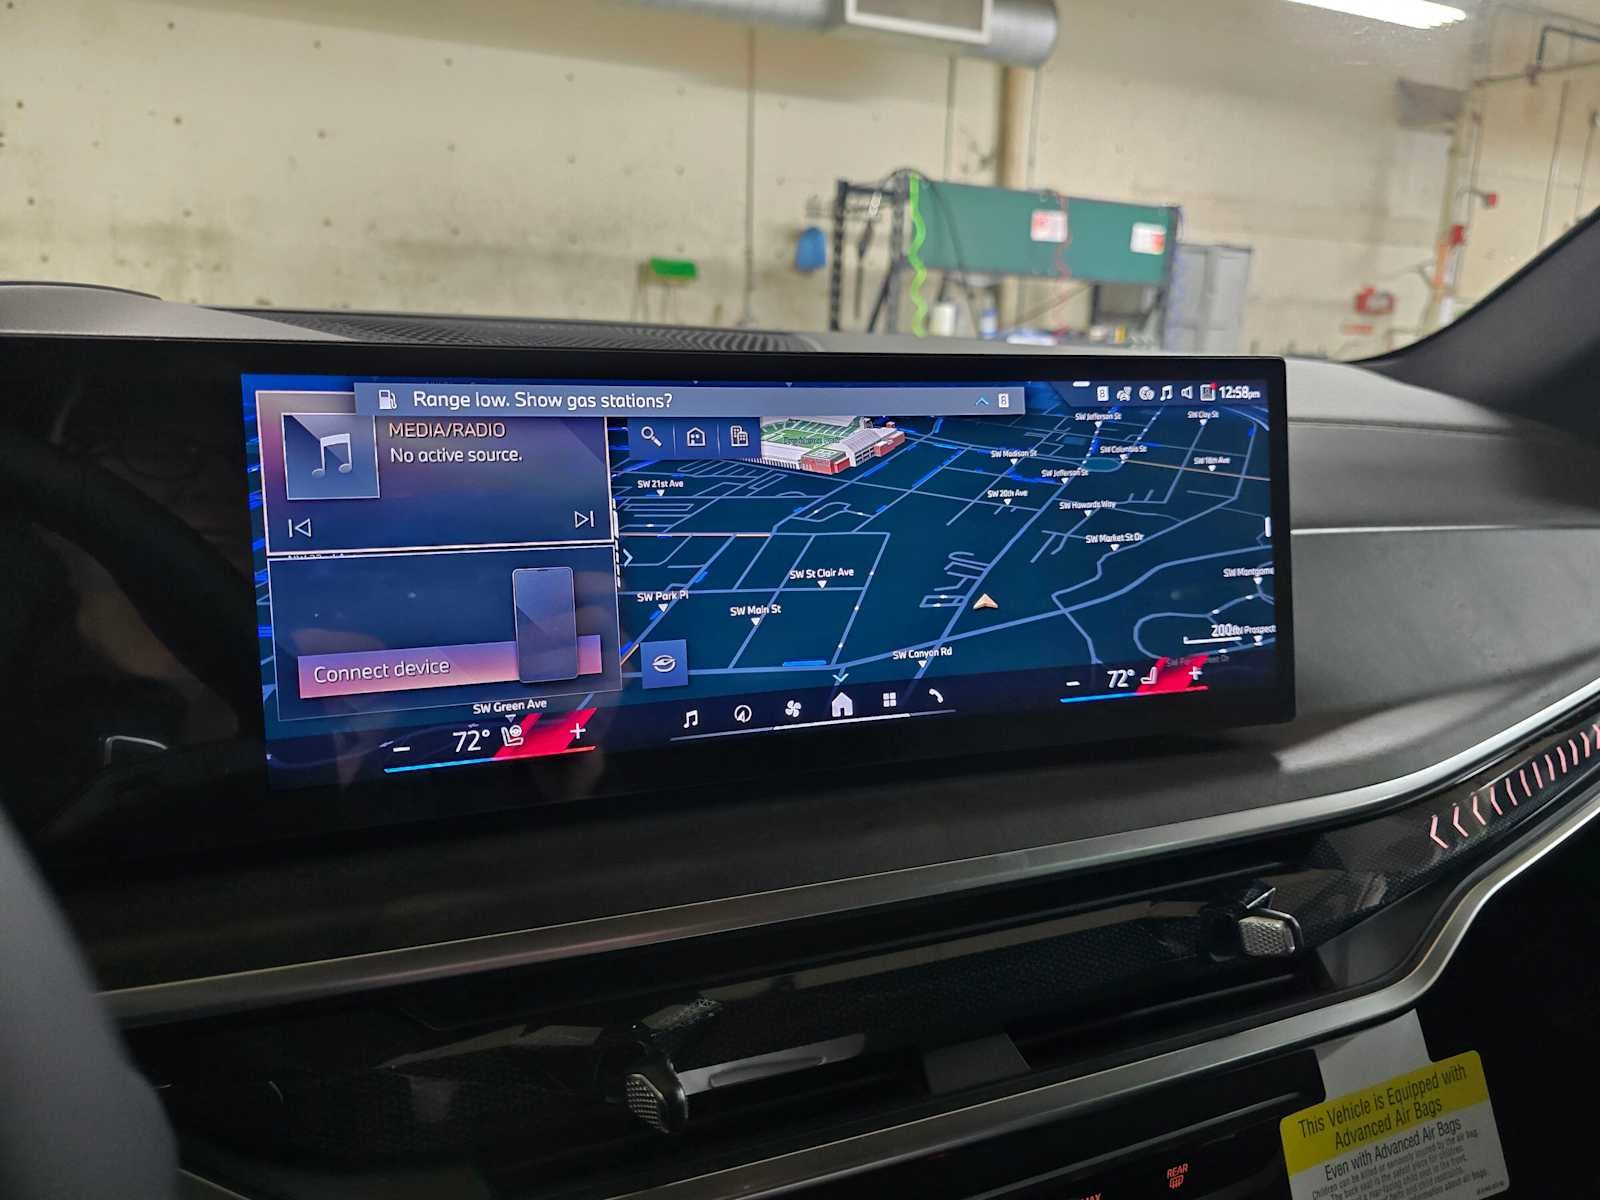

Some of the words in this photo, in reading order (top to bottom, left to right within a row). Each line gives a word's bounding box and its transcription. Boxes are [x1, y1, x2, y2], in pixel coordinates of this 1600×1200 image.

[1219, 386, 1261, 399] 12:58pm
[413, 390, 471, 410] Range
[476, 390, 510, 408] low.
[514, 392, 564, 408] Show
[567, 396, 596, 411] gas
[601, 392, 673, 409] stations?
[389, 422, 506, 438] MEDIA/RADIO
[390, 448, 414, 463] No
[418, 448, 464, 463] active
[468, 450, 523, 462] source.
[637, 480, 649, 488] SW
[650, 480, 668, 488] 21st
[669, 480, 684, 488] Ave
[988, 490, 998, 498] SW
[1086, 535, 1098, 544] SW
[1098, 534, 1123, 543] Market
[790, 570, 804, 579] SW
[806, 570, 816, 579] St
[817, 569, 836, 578] Clair
[838, 568, 854, 577] Ave
[637, 593, 653, 602] SW
[655, 592, 677, 601] Park
[730, 607, 746, 616] SW
[747, 606, 767, 616] Main
[769, 605, 781, 614] St
[892, 650, 907, 660] SW
[908, 649, 939, 661] Canyon
[940, 647, 952, 656] Rd
[314, 663, 388, 683] Connect
[394, 658, 450, 678] device
[473, 704, 491, 714] SW
[493, 700, 524, 712] Green
[526, 699, 548, 710] Ave
[452, 729, 491, 753] 72°
[1298, 1118, 1326, 1138] This
[1326, 1100, 1371, 1127] Vehicle
[1374, 1092, 1385, 1111] is
[1387, 1074, 1440, 1106] Equipped
[1441, 1063, 1467, 1085] with
[1335, 1119, 1392, 1150] Advanced
[1394, 1108, 1411, 1127] Air
[1414, 1098, 1443, 1120] Bags
[1325, 1161, 1349, 1181] Even
[1351, 1150, 1373, 1173] with
[1374, 1133, 1421, 1162] Advanced
[1423, 1126, 1436, 1142] Air
[1437, 1116, 1462, 1138] Bags
[1167, 1163, 1189, 1178] REAR
